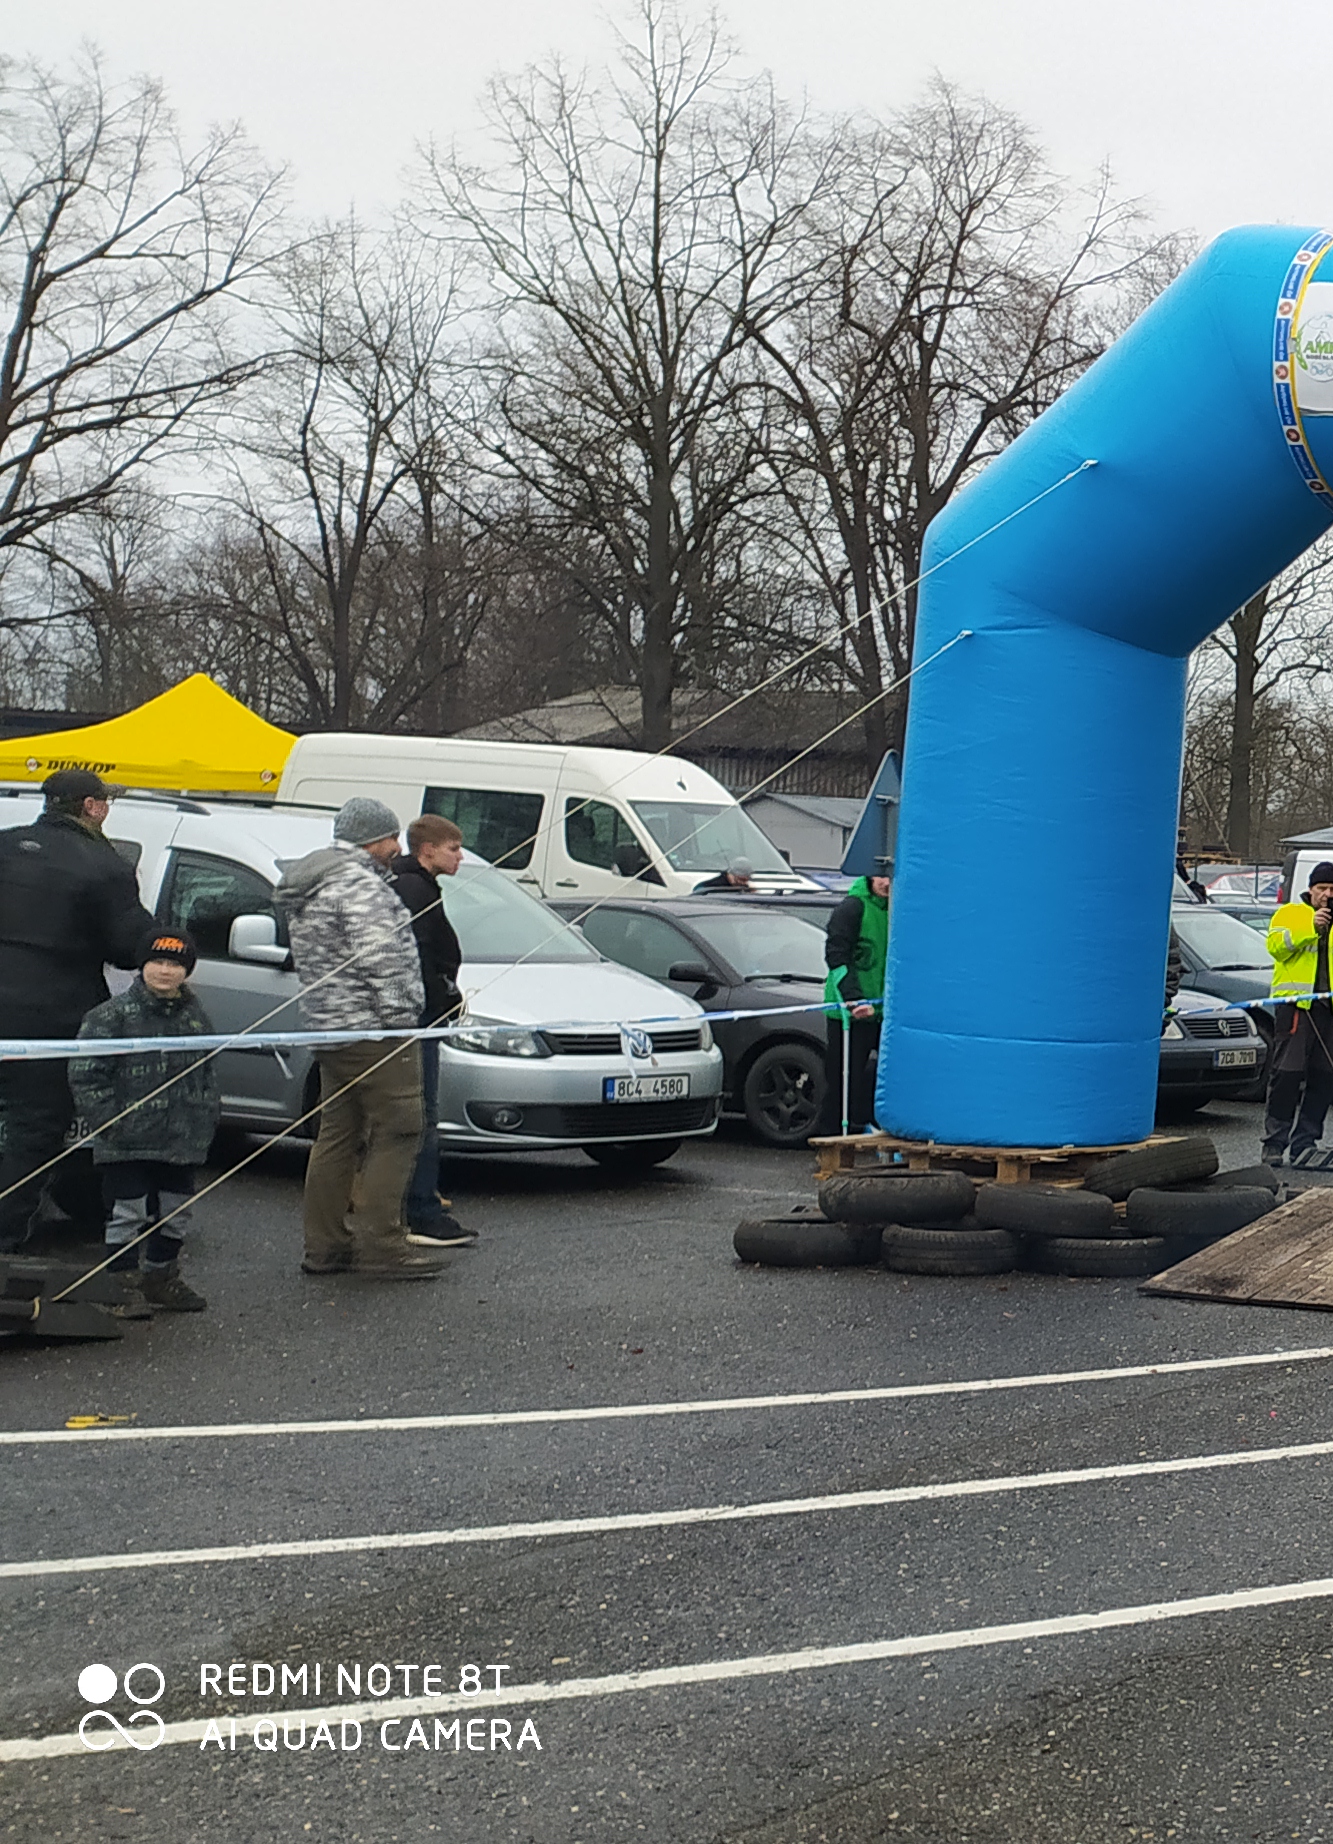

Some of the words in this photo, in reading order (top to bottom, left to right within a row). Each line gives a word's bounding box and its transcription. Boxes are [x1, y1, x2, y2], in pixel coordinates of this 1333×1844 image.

[46, 760, 116, 773] DUNLOP
[618, 1080, 642, 1097] 8C4
[652, 1078, 683, 1096] 4580
